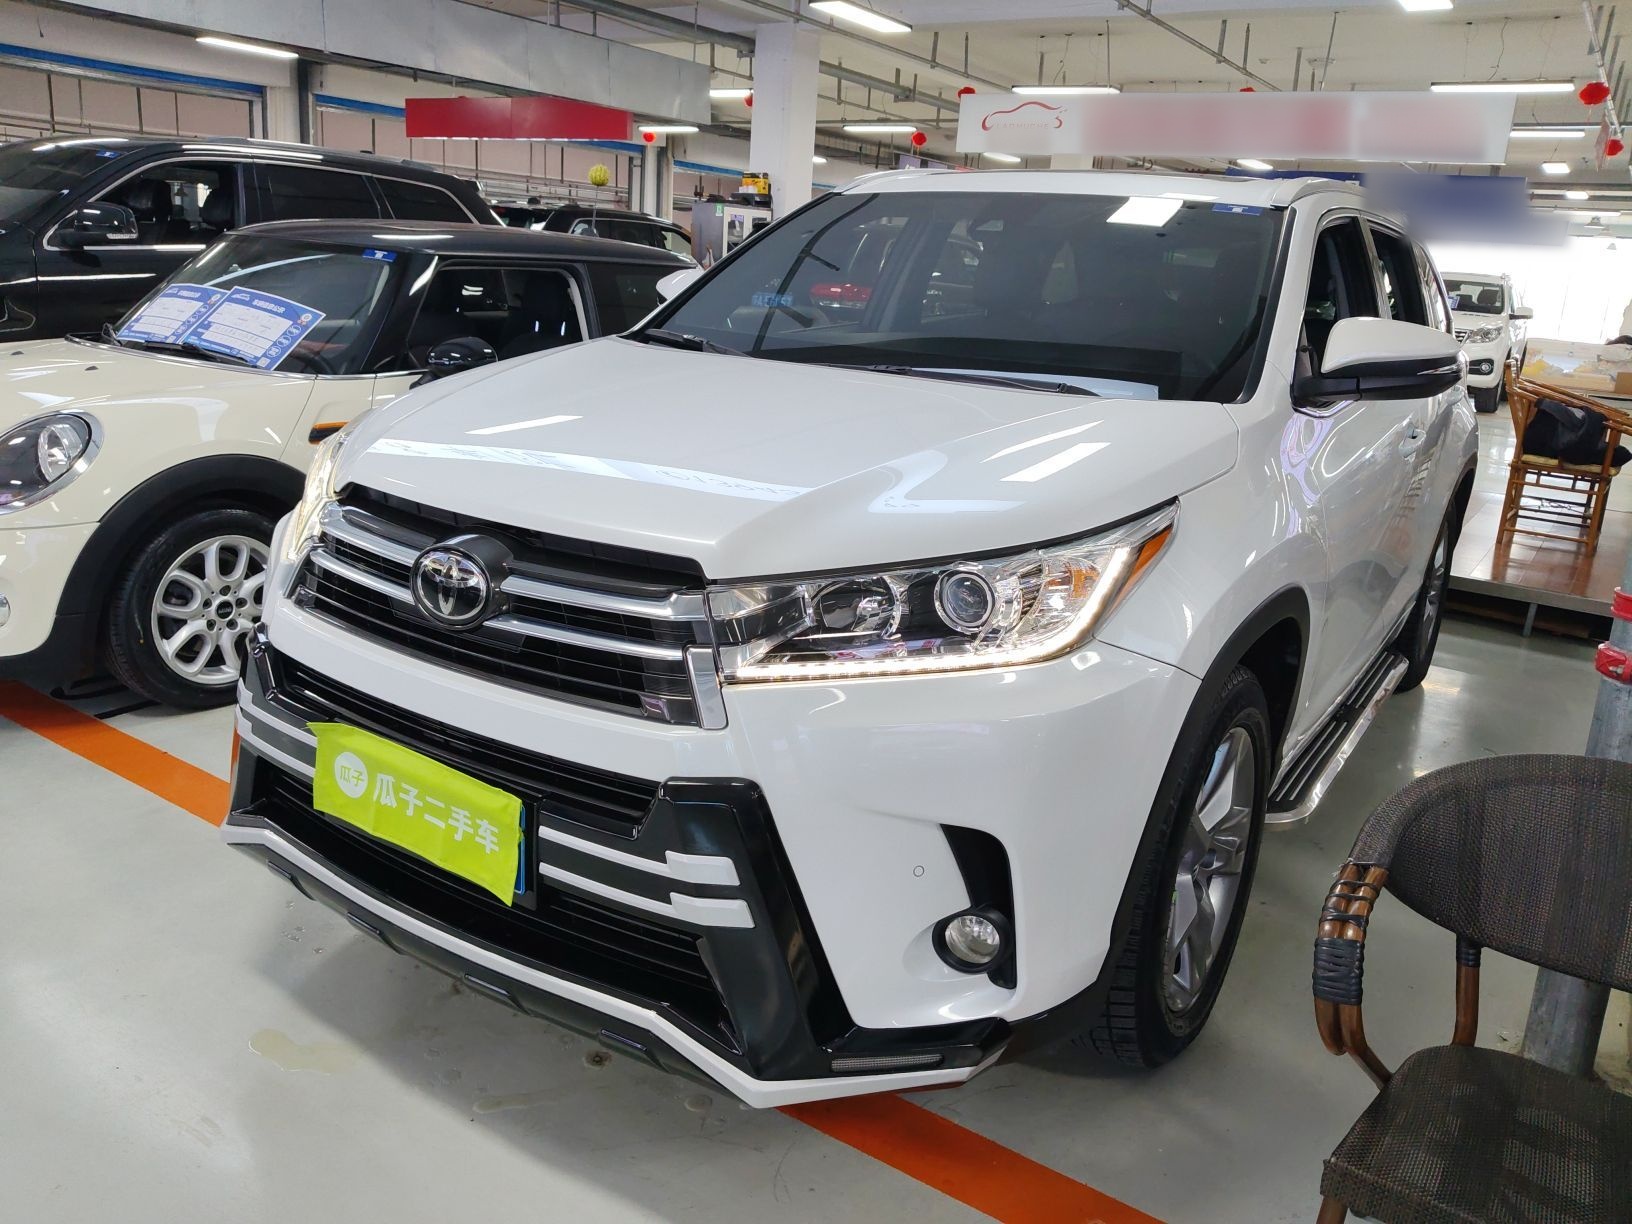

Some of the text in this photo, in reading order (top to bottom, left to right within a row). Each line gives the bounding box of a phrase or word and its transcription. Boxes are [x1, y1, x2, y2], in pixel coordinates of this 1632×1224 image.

[340, 765, 365, 787] 瓜子
[373, 773, 499, 854] 瓜子二手车
